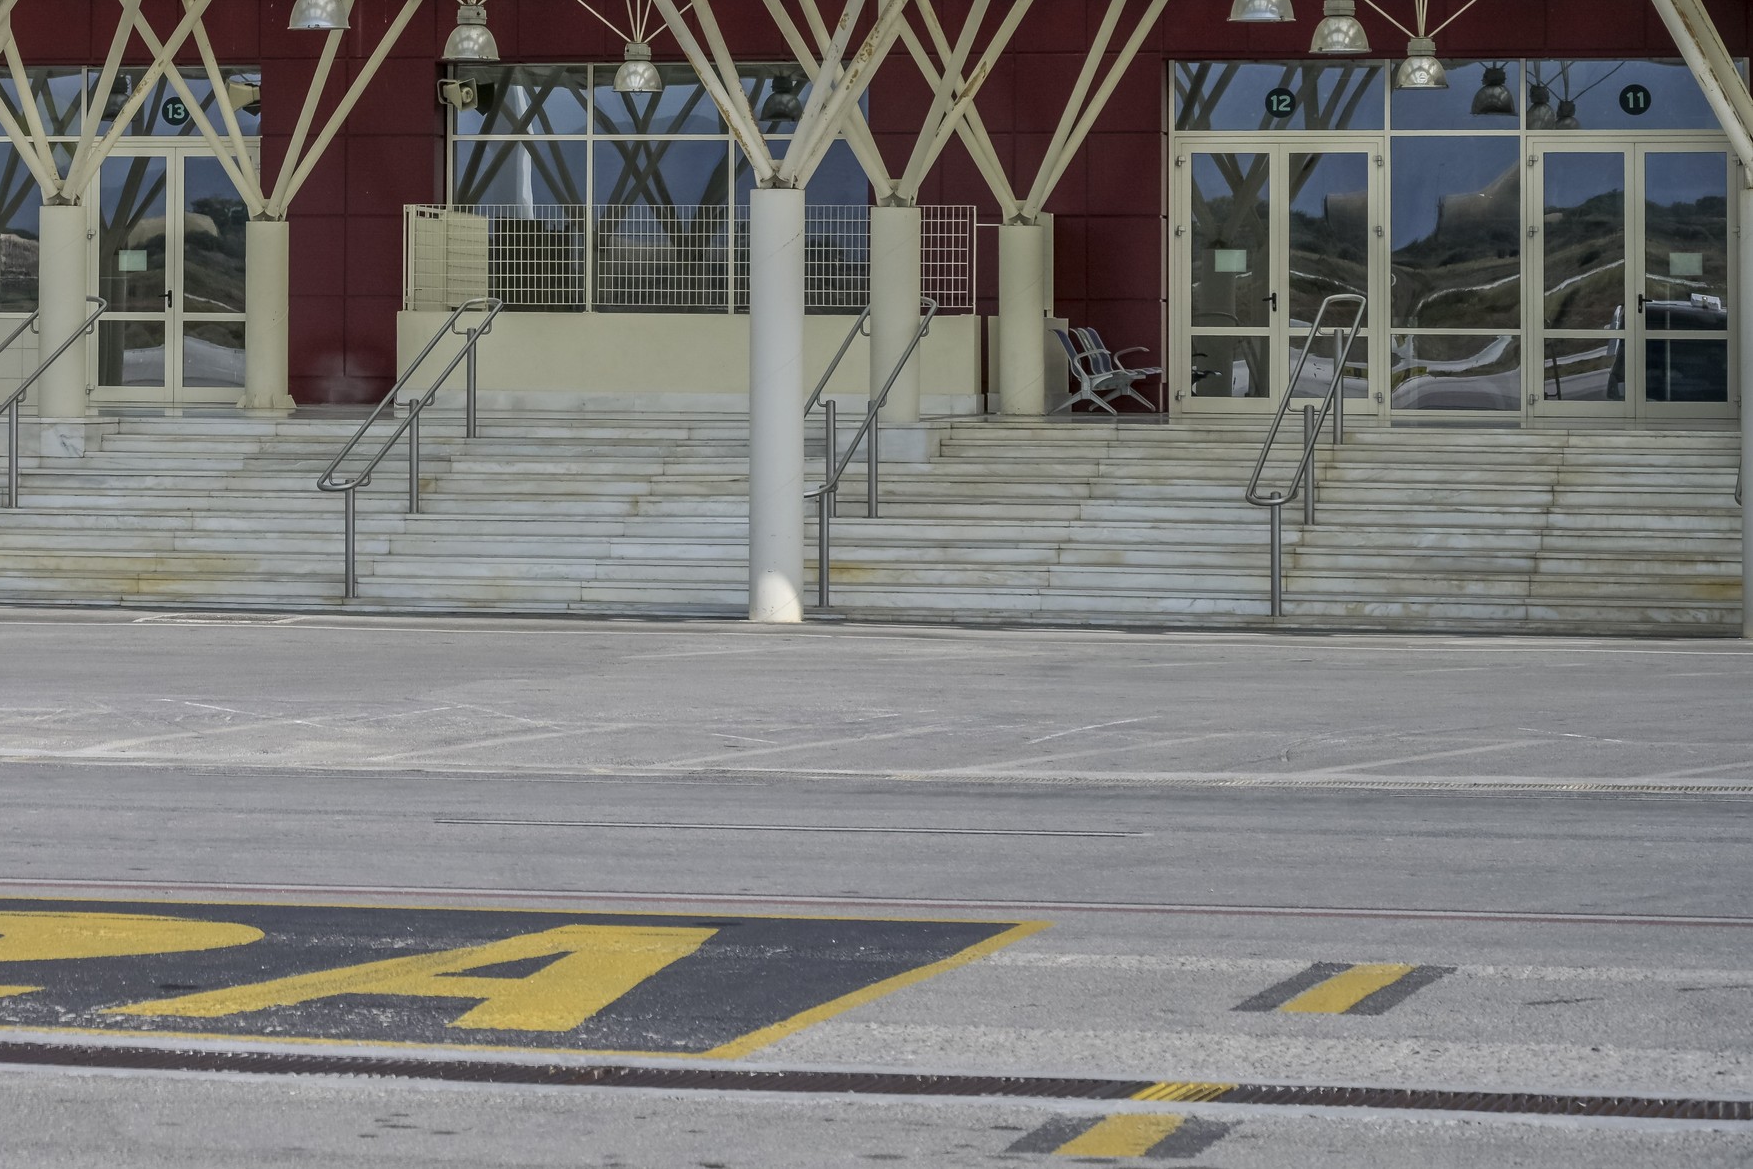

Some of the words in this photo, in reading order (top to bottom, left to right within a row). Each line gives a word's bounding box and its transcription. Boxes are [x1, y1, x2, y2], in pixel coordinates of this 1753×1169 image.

[1270, 94, 1292, 112] 12
[1626, 91, 1645, 109] 11
[166, 103, 186, 119] 13
